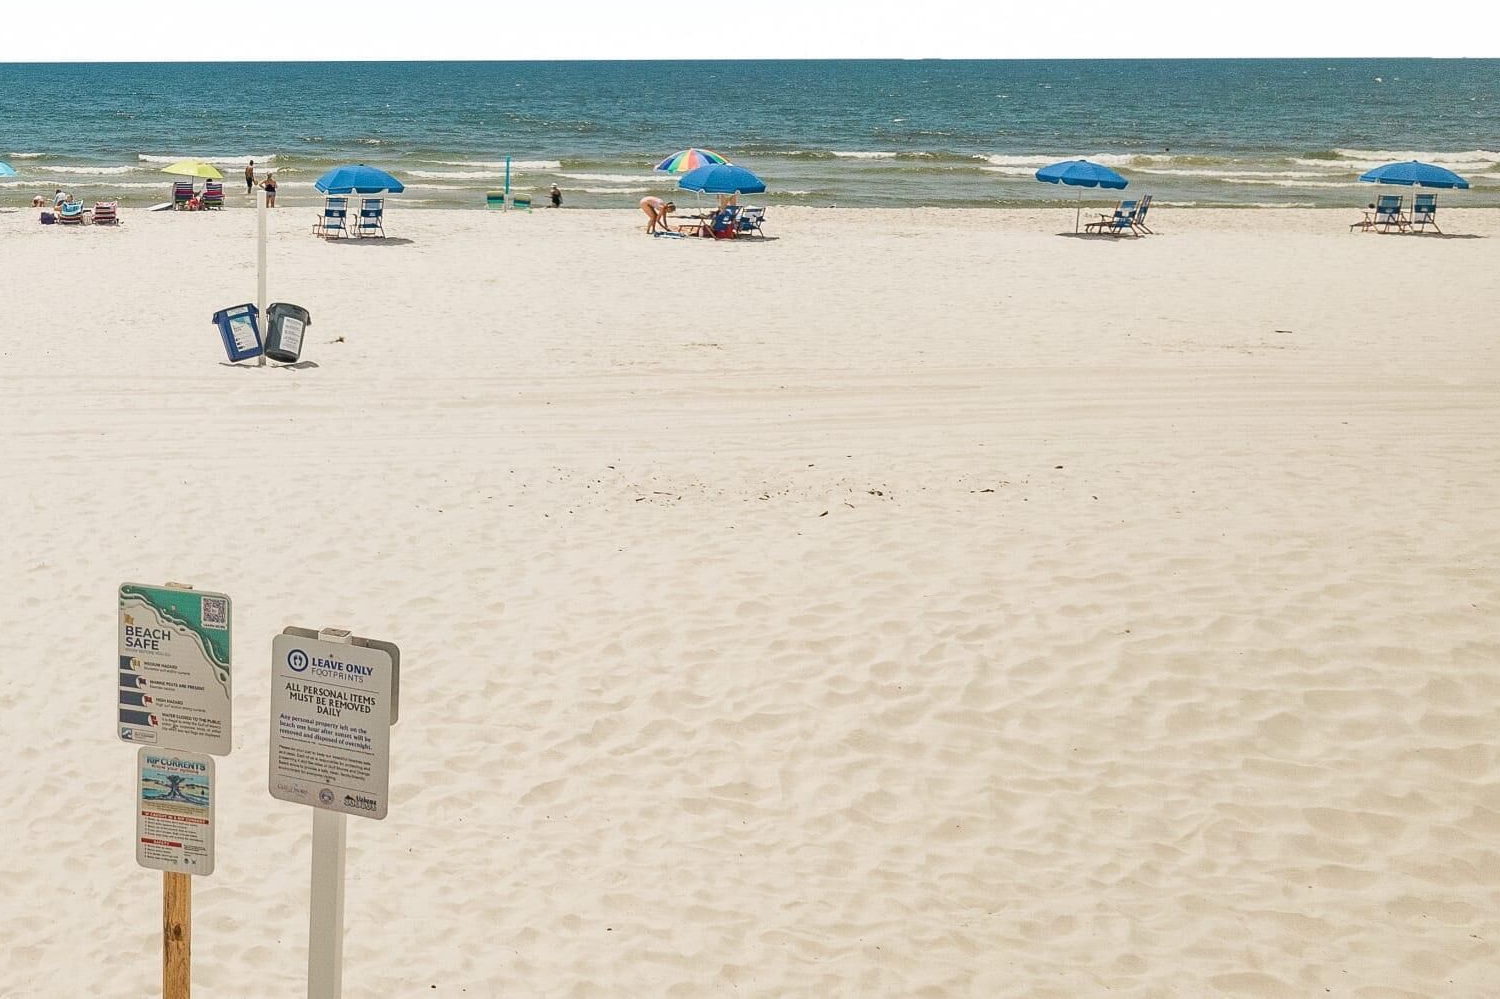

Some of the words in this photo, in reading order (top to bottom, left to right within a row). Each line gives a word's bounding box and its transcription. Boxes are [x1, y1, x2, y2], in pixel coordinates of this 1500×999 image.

[125, 625, 171, 641] BEACH
[125, 637, 159, 651] SAFE
[312, 657, 344, 671] LEAVE
[345, 663, 374, 677] ONLY
[311, 668, 364, 684] FOOTPRINTS
[285, 682, 301, 692] ALL
[303, 684, 348, 701] PERSONAL
[350, 693, 376, 706] ITEMS
[289, 692, 314, 704] MUST
[316, 697, 326, 706] BE
[328, 698, 371, 714] REMOVED
[317, 705, 341, 717] DAILY
[280, 720, 296, 728] beach
[307, 725, 320, 733] hour
[321, 727, 333, 735] after
[335, 731, 352, 739] sunset
[353, 733, 364, 741] will
[291, 715, 315, 725] personal
[315, 720, 339, 730] property
[280, 728, 303, 737] removed
[303, 731, 313, 739] and
[160, 757, 206, 771] CURRENTS
